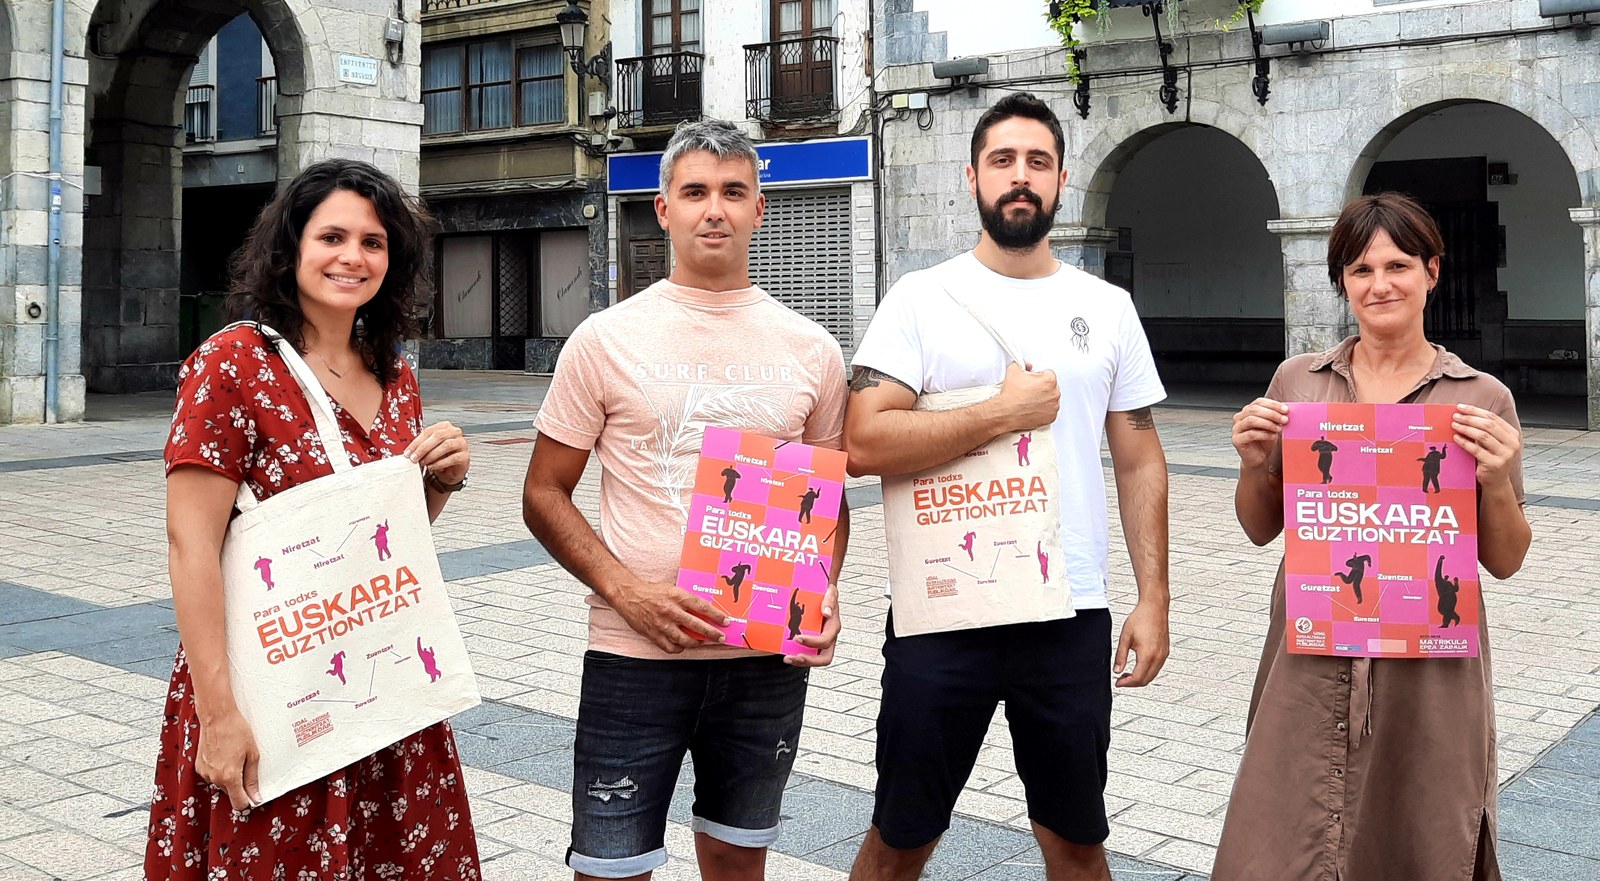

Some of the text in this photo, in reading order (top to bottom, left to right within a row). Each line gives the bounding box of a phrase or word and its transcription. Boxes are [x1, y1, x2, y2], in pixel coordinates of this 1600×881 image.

[635, 362, 793, 382] SURF CLUB
[1320, 422, 1364, 432] Niretzat
[734, 454, 768, 466] Niretzat
[913, 473, 964, 486] Para todxs
[913, 476, 1048, 510] EUSKARA
[1296, 489, 1358, 499] Para todxs
[706, 505, 752, 520] Para todxs
[916, 498, 1048, 526] GUZTIONTZAT
[1296, 501, 1458, 528] EUSKARA
[701, 515, 818, 553] EUSKARA
[1297, 526, 1460, 545] GUZTIONTZAT
[282, 536, 320, 556] Niretzat
[700, 534, 818, 566] GUZTIONTZAT
[314, 554, 345, 570] Hiretzat
[1377, 573, 1413, 581] Zuentzat
[1300, 584, 1341, 592] Guretzat
[253, 589, 318, 622] Para todxs
[256, 566, 420, 649] EUSKARA
[266, 587, 422, 665] GUZTIONTZAT
[366, 644, 394, 660] Zuentzat
[286, 690, 320, 708] Guretzat
